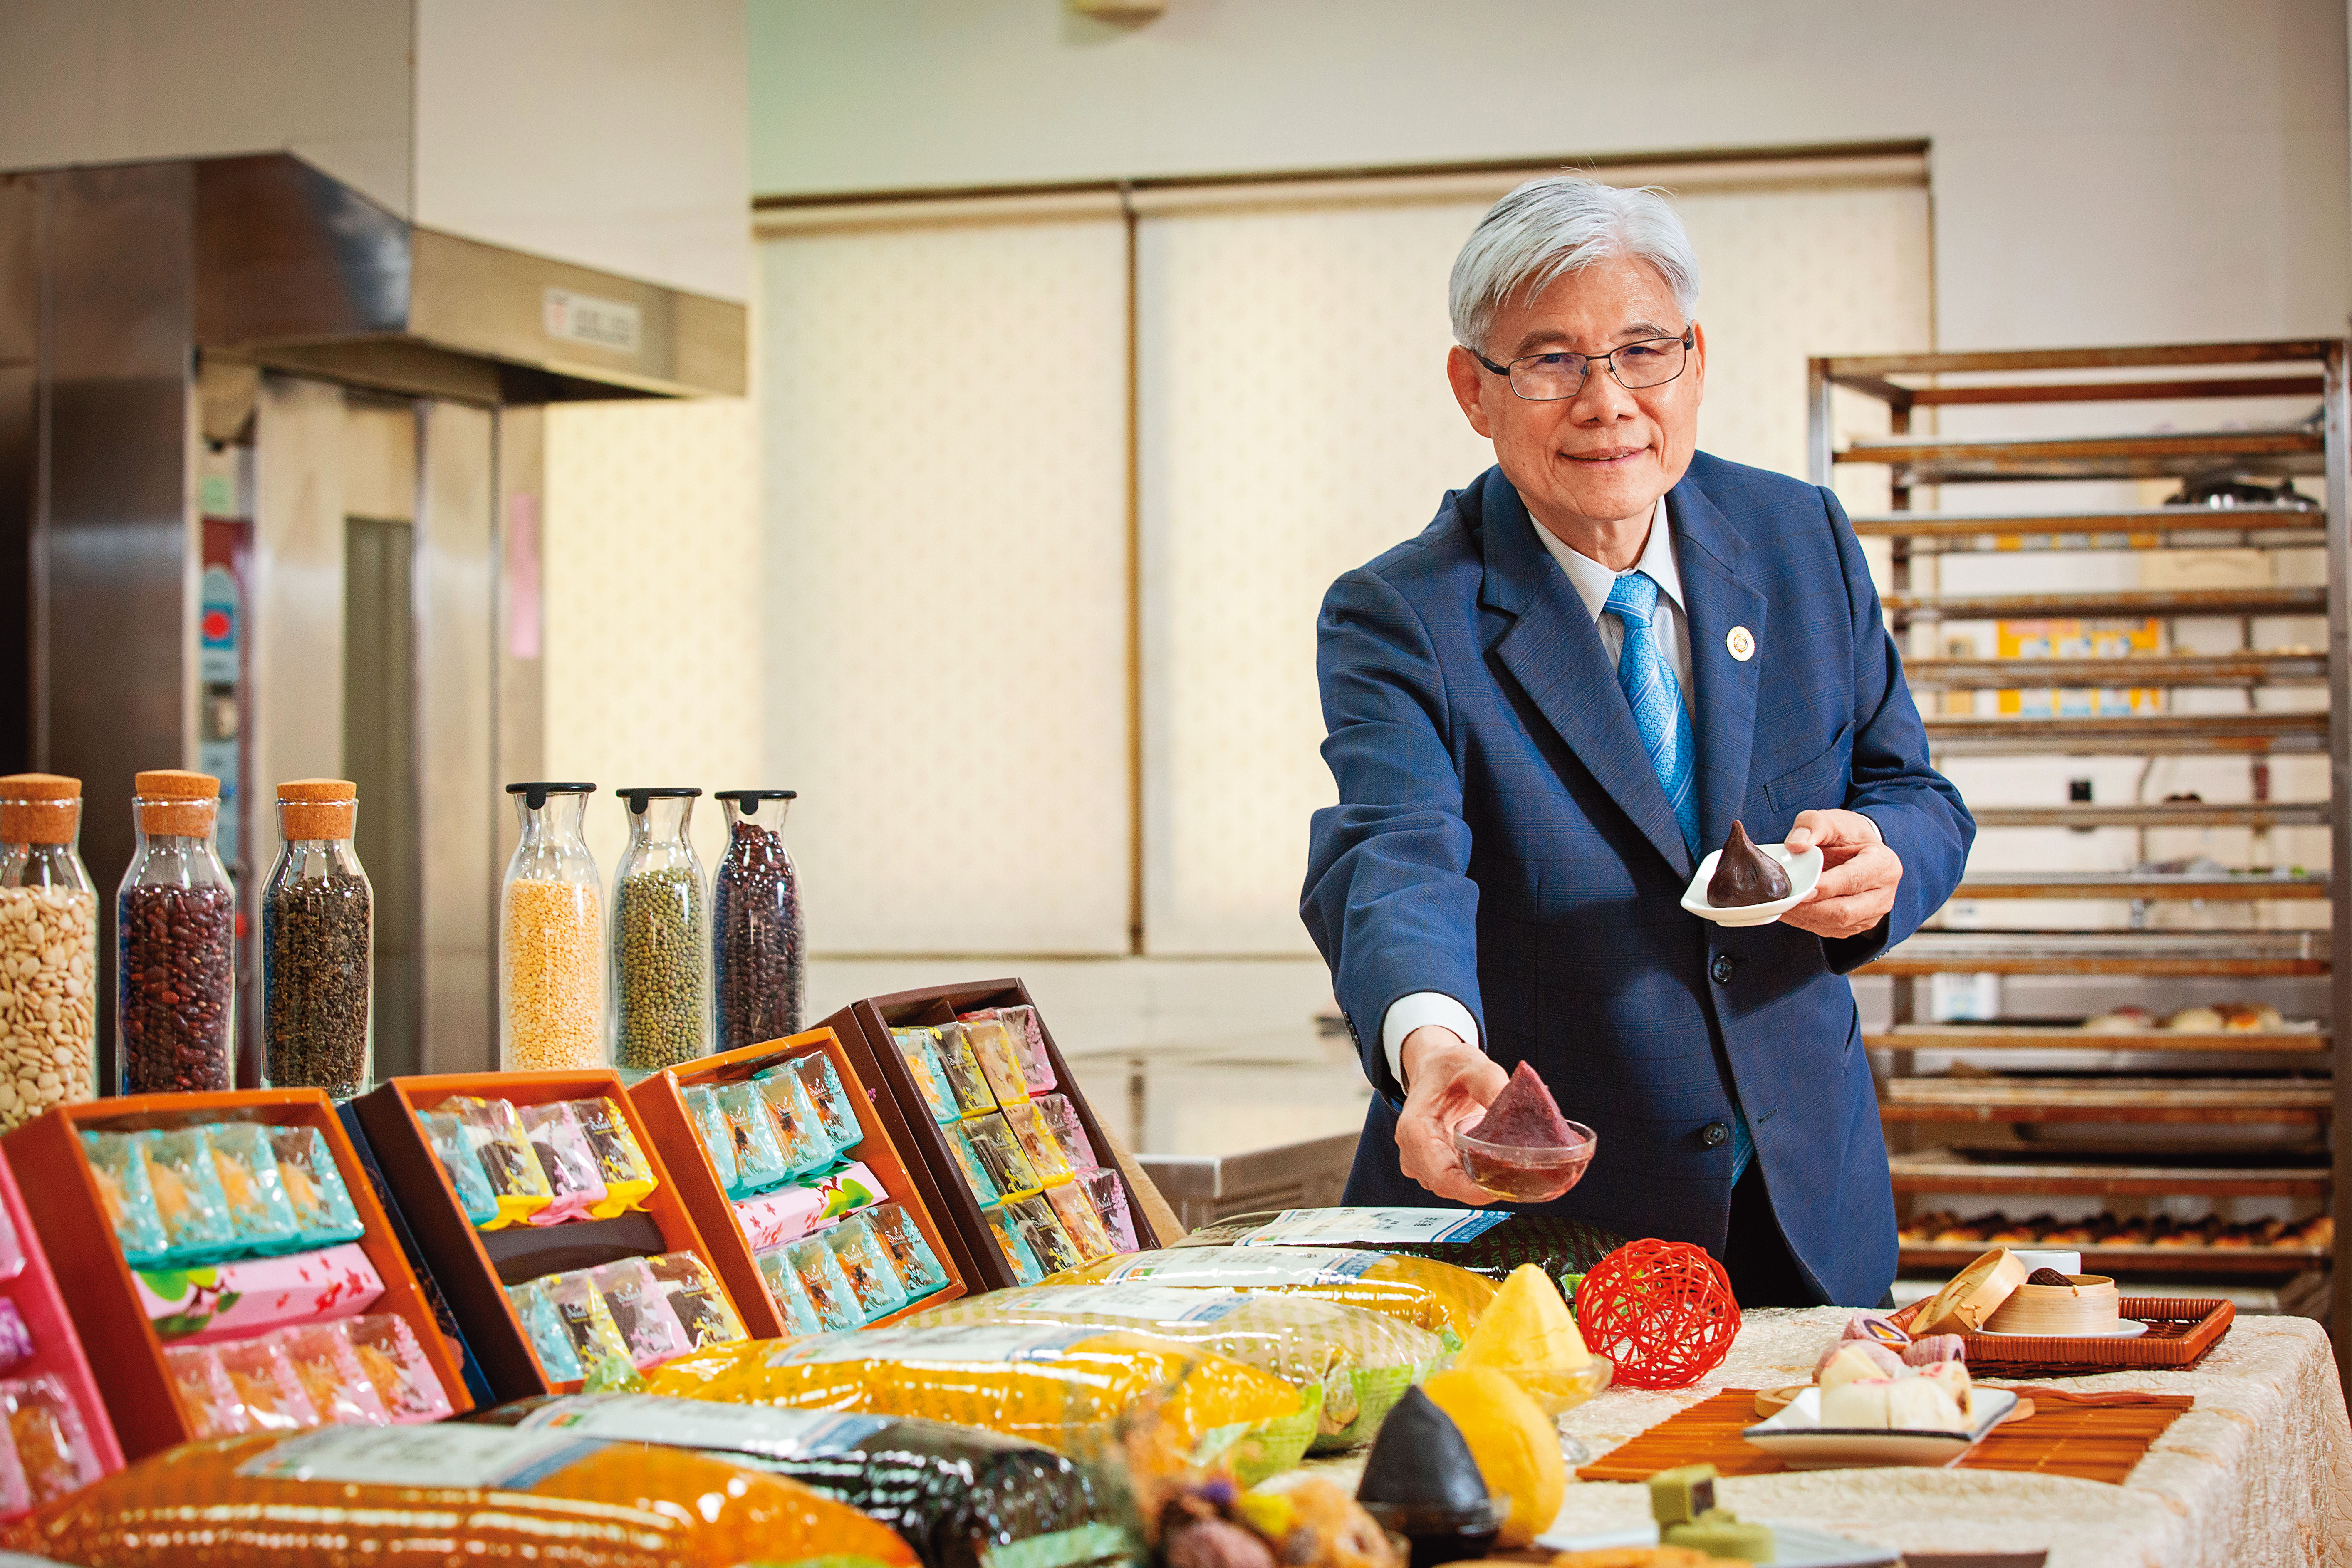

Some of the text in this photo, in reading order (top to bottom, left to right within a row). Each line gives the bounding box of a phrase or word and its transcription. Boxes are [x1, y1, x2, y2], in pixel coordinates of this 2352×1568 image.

[808, 1083, 827, 1096] Sweet
[776, 1102, 795, 1115] Sweet
[730, 1110, 747, 1124] Sweet
[885, 1230, 905, 1243] Sweet
[842, 1248, 864, 1262] Sweet
[804, 1269, 823, 1283] Sweet
